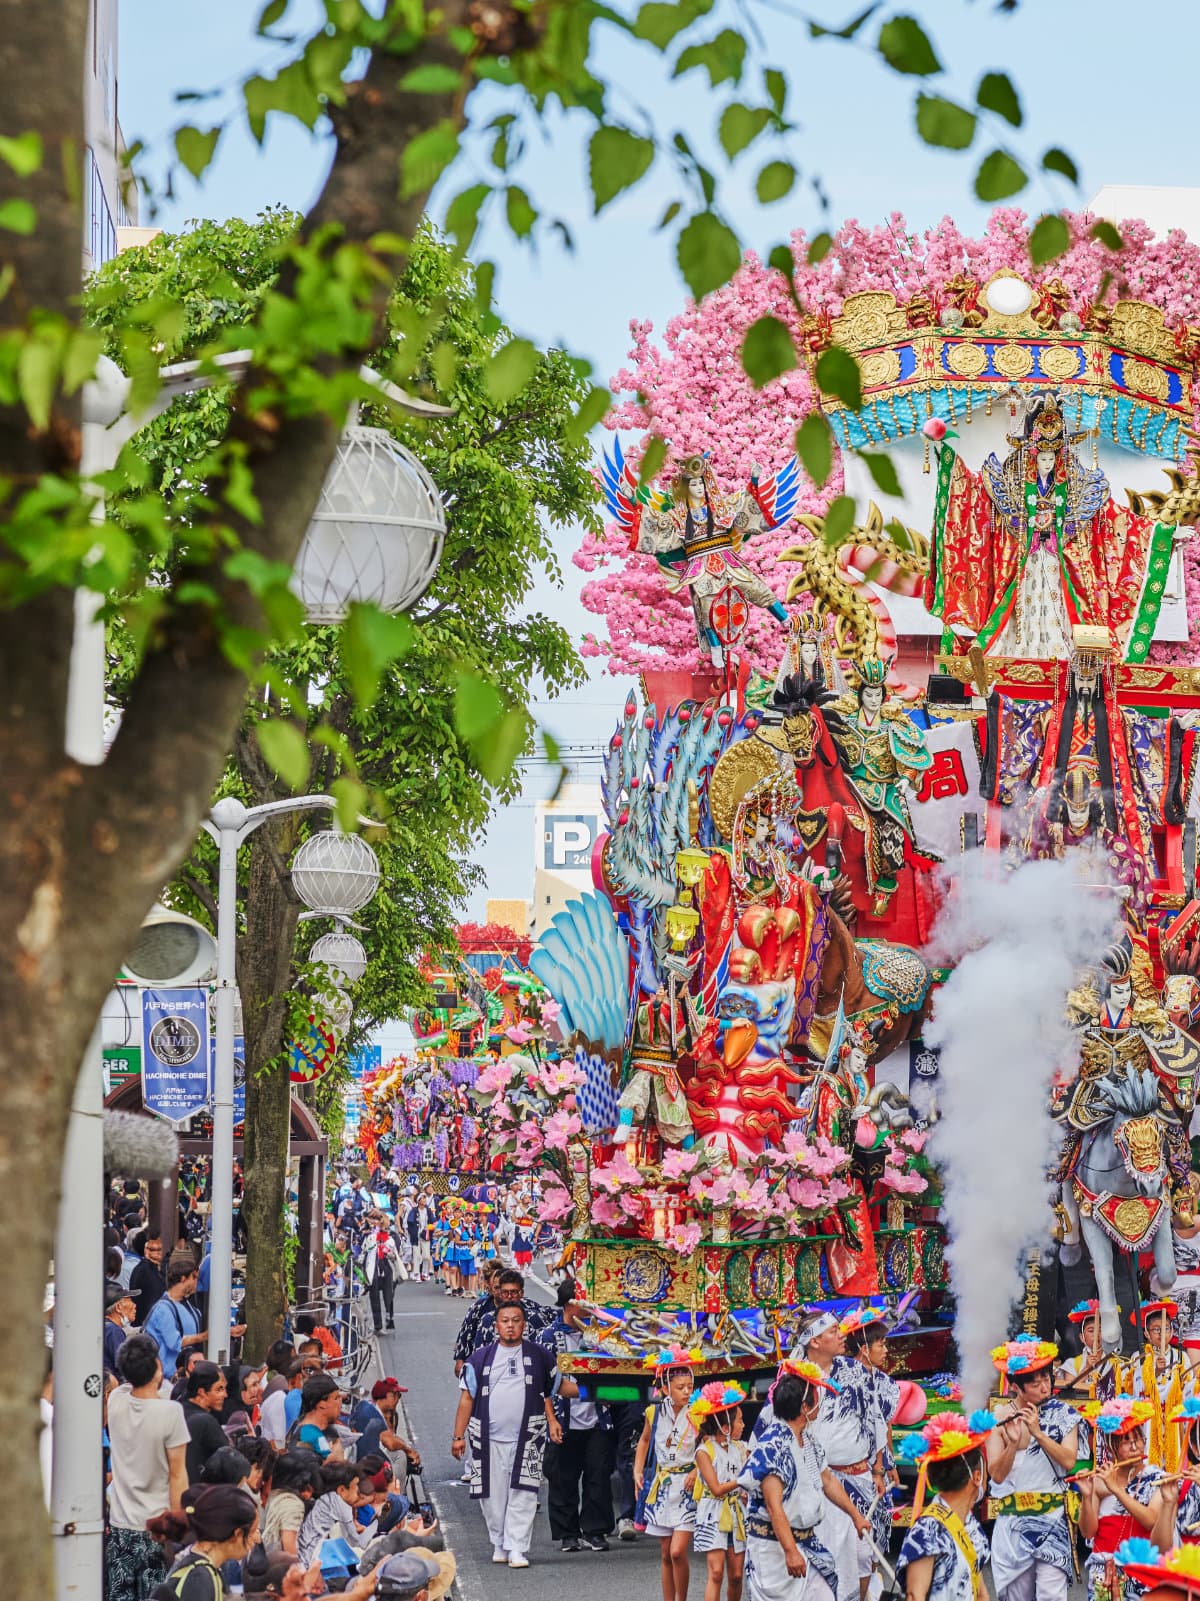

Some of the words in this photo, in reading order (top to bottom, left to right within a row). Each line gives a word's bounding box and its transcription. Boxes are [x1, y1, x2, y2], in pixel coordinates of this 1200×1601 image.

[917, 748, 969, 801] 周
[553, 821, 591, 865] P
[154, 1035, 196, 1047] DIME
